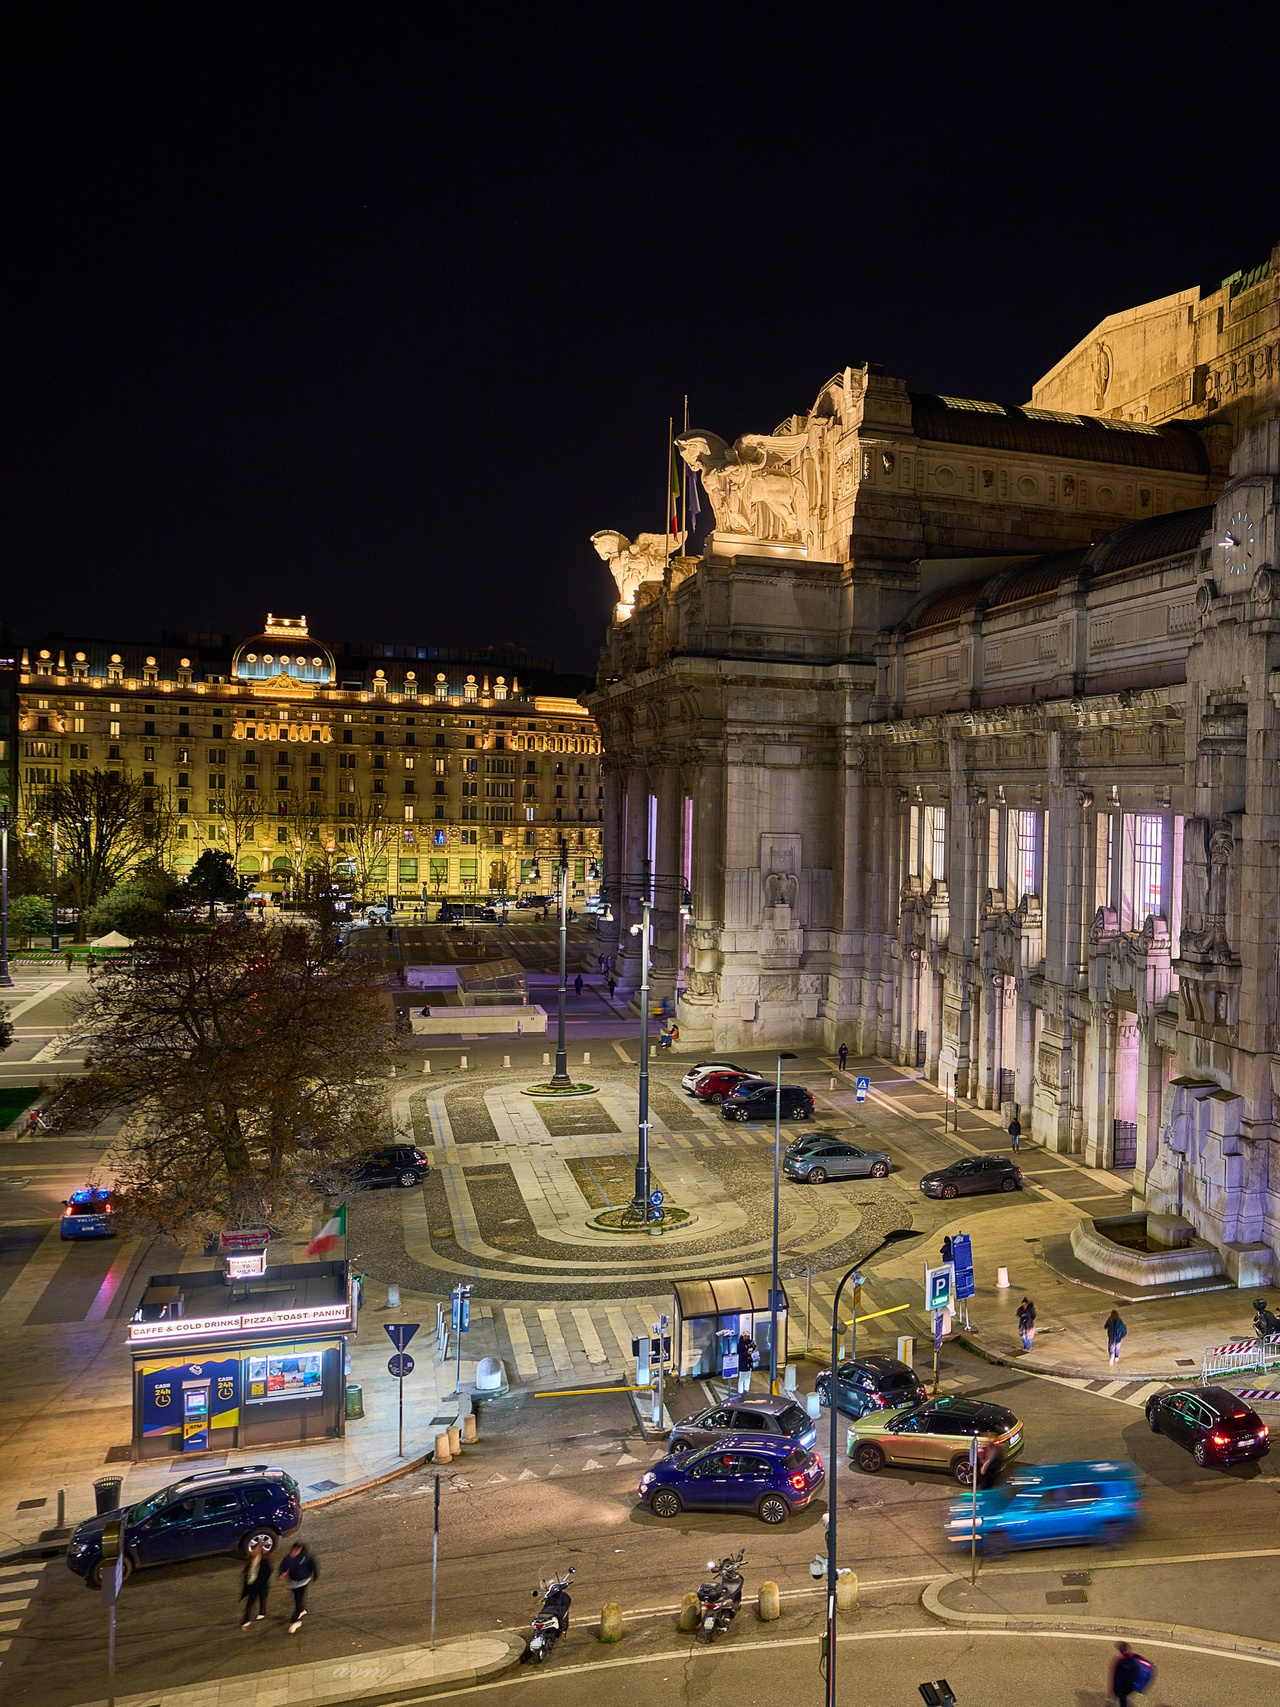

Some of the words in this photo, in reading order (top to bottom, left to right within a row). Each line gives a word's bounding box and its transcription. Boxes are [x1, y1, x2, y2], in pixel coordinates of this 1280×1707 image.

[936, 1278, 946, 1297] P
[313, 1309, 345, 1318] PANINI
[133, 1325, 163, 1336] CAFFE
[176, 1321, 202, 1331] COLD
[204, 1318, 240, 1329] DRINKS
[218, 1381, 234, 1389] 24h
[155, 1388, 171, 1396] 24h
